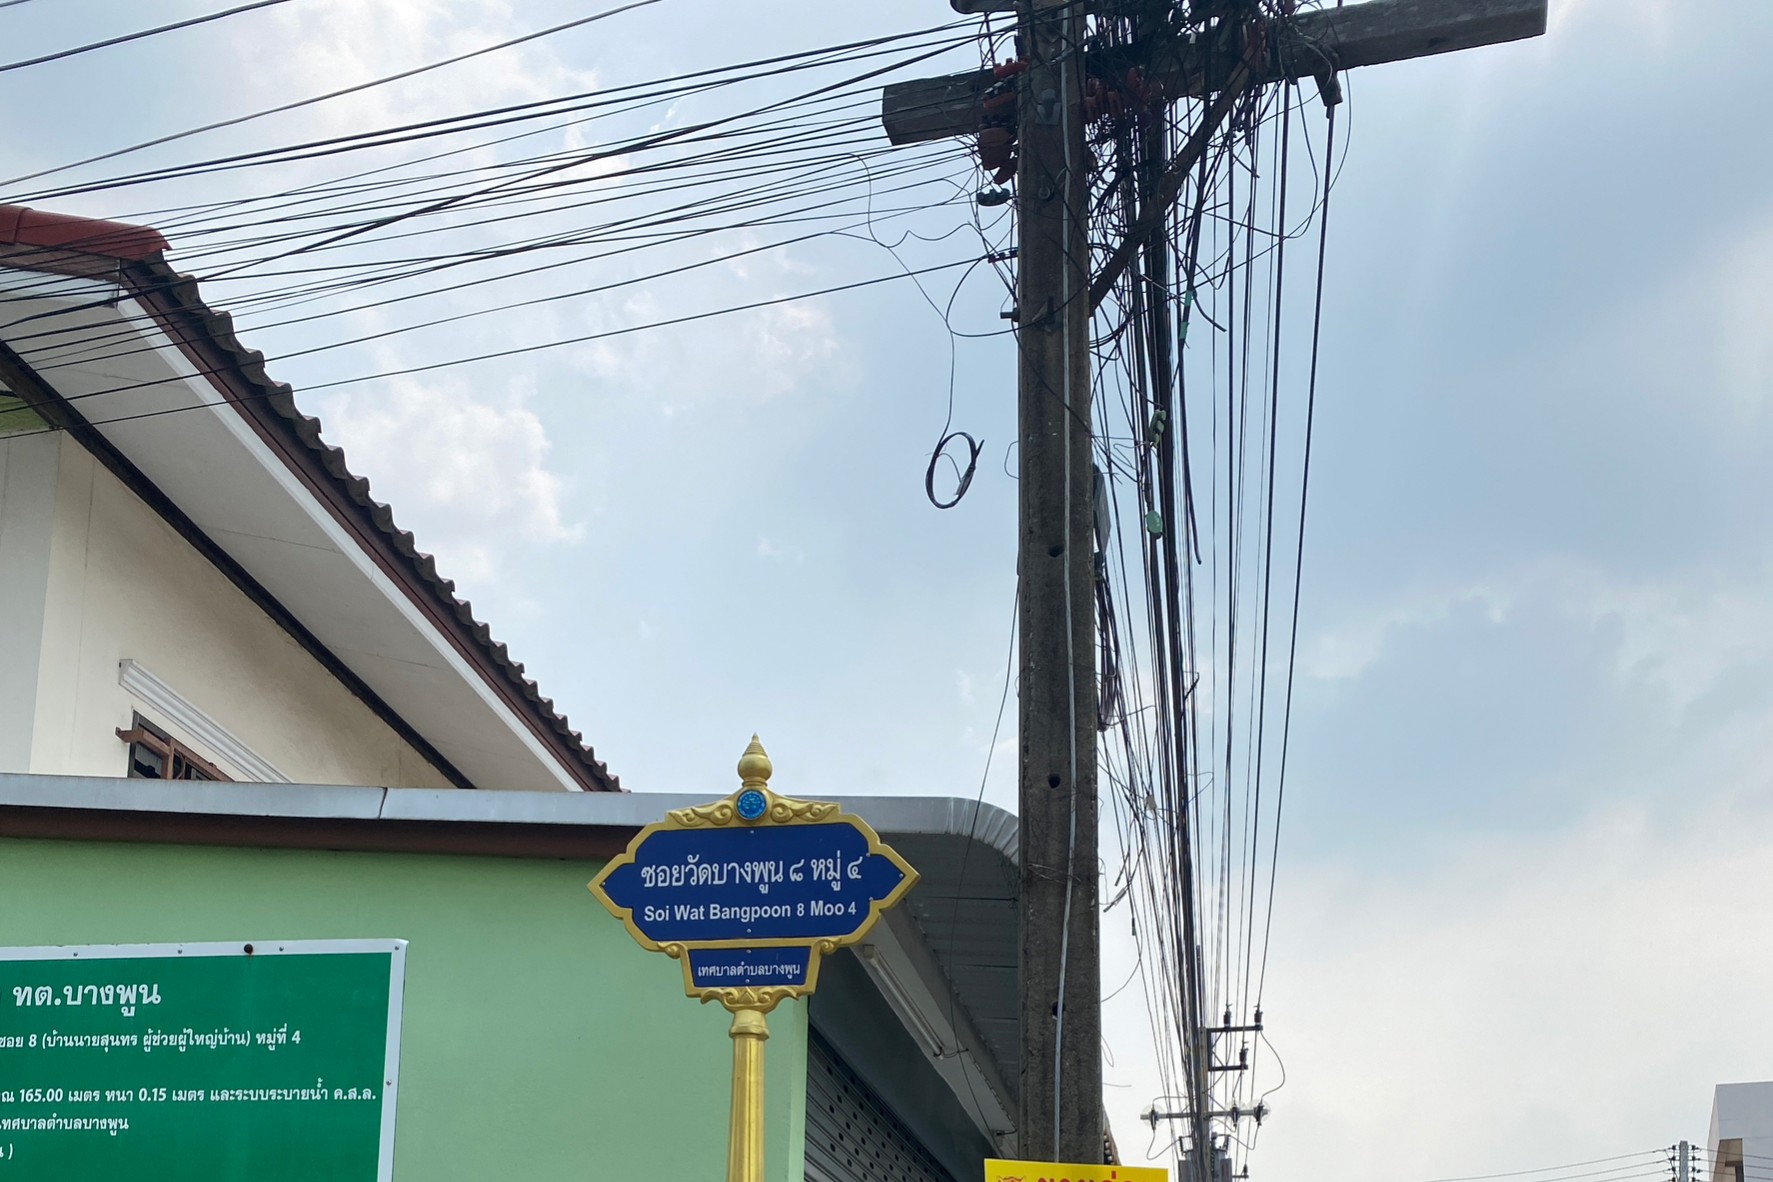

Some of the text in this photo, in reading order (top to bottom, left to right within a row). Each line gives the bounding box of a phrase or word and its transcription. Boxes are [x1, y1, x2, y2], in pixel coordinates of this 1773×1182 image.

[641, 850, 863, 894] ซอยวัดบางพูน ๘ หมู่ ๔
[644, 900, 857, 922] Soi Wat Bangpoon 8 Moo 4
[698, 961, 800, 979] เทศบาลตำบลบางพูน
[13, 983, 161, 1017] ทต.บางพูน
[28, 1034, 37, 1048] 8
[42, 1029, 138, 1053] (บ้านนายสุนทร
[143, 1028, 251, 1053] ผู้ช่วยผู้ใหญ่บ้าน)
[255, 1023, 287, 1051] หมู่ที่
[291, 1030, 301, 1045] 4
[19, 1088, 64, 1103] 165.00
[68, 1089, 101, 1102] เมตร
[105, 1089, 134, 1102] หนา
[138, 1087, 167, 1102] 0.15
[172, 1088, 205, 1102] เมตร
[210, 1077, 329, 1101] และระบบระบายน้ำ
[334, 1087, 377, 1101] ค.ส.ล.
[0, 1113, 129, 1136] ทศบาลตำบลบางพูน
